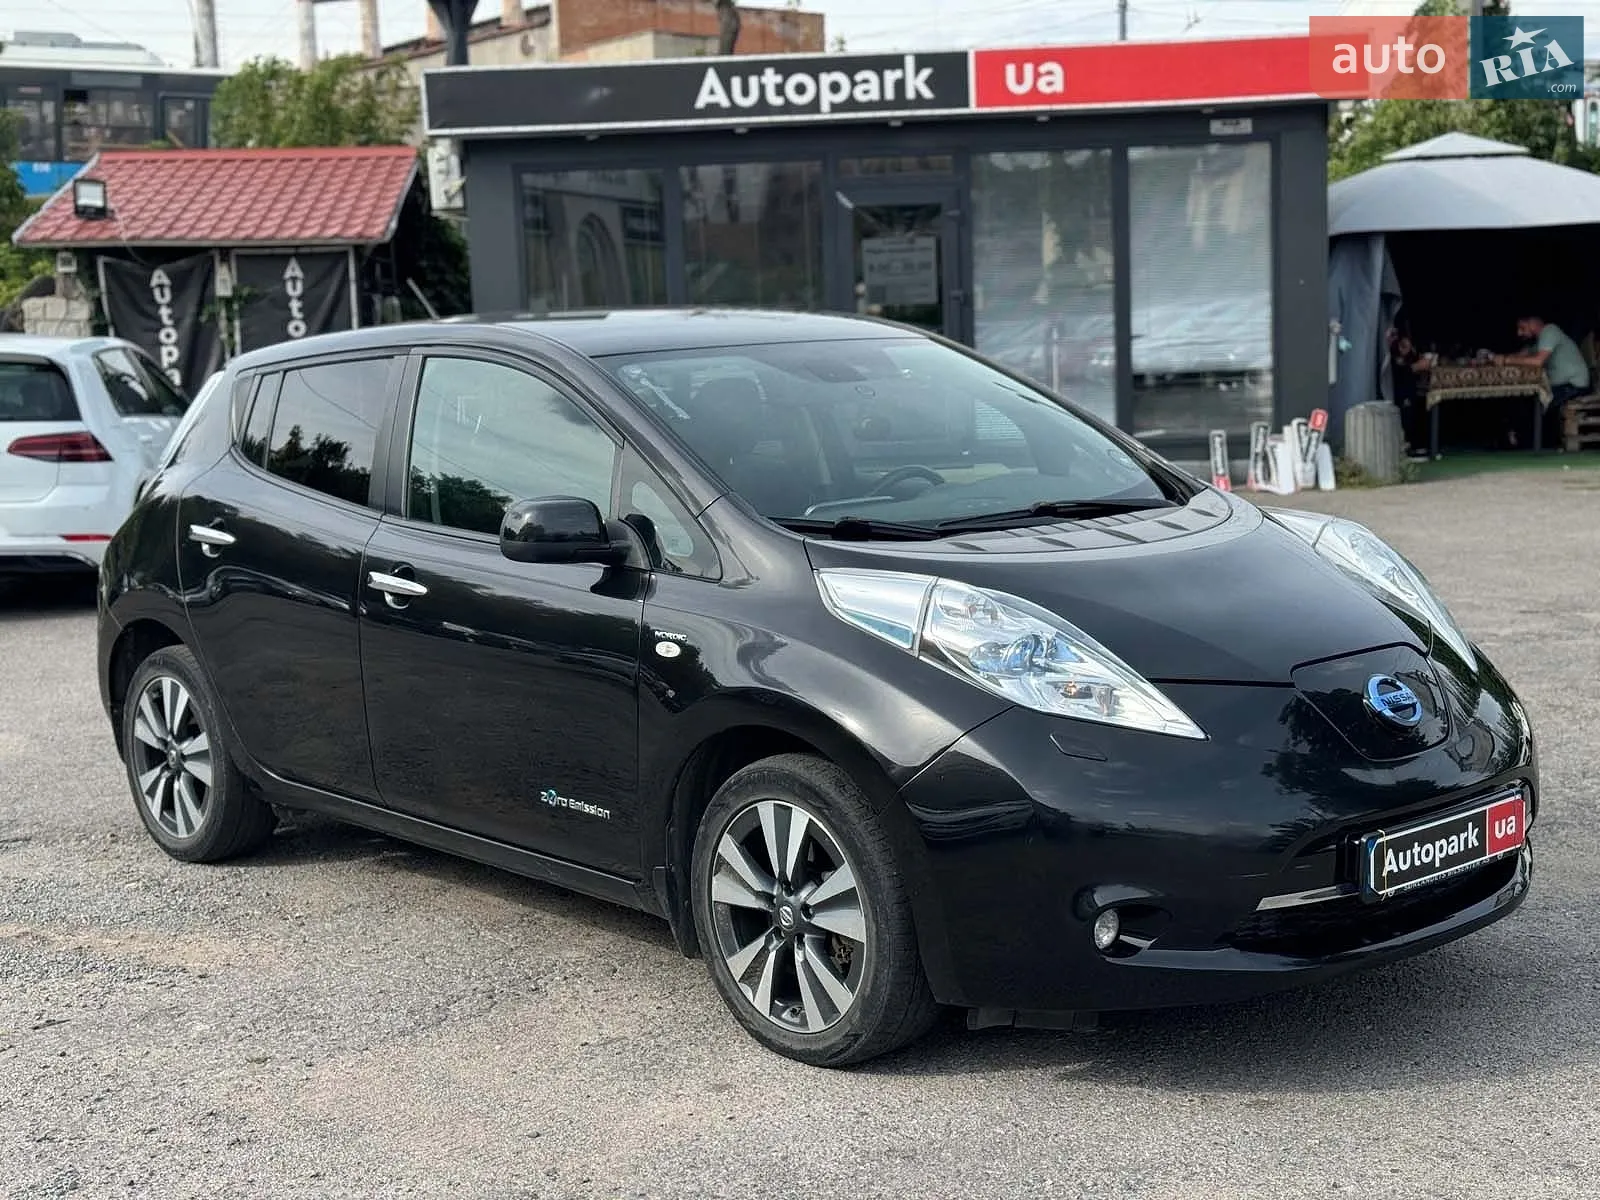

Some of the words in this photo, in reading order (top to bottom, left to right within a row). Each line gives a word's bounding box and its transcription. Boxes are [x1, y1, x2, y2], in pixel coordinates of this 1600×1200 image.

[695, 55, 934, 113] Autopark
[1004, 60, 1065, 95] ua
[654, 630, 688, 641] NORDIC
[1383, 822, 1479, 875] Autopark
[1494, 815, 1516, 840] ua
